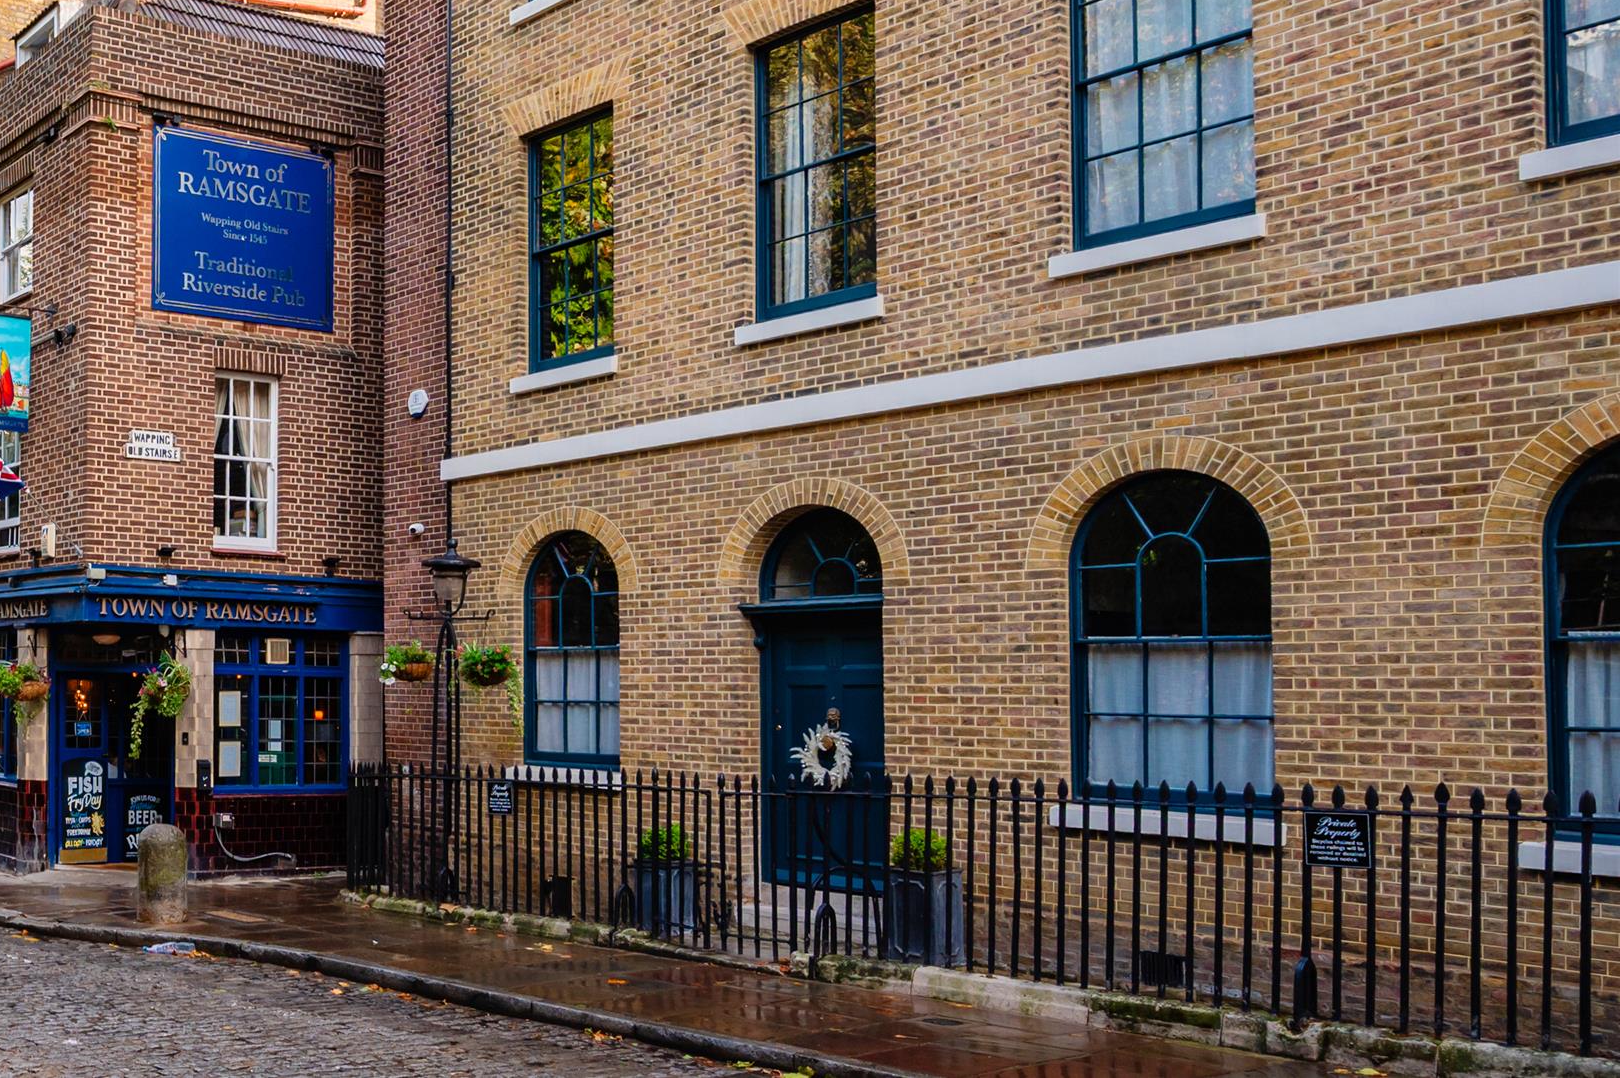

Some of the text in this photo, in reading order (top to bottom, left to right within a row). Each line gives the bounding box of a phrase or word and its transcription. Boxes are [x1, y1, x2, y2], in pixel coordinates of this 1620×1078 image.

[203, 149, 288, 184] Town of
[178, 171, 312, 214] RAMSGATE
[201, 212, 289, 235] Wapping Old Stairs
[223, 228, 268, 245] Since 1545
[194, 250, 294, 283] Traditional
[182, 272, 306, 307] Riverside Pub
[133, 432, 171, 445] WAPPING
[128, 446, 143, 456] OLD
[144, 447, 173, 459] STAIRS
[96, 597, 318, 623] TOWN OF RAMSGATE
[68, 776, 103, 795] FISH
[128, 810, 157, 825] BEER
[1317, 816, 1357, 827] Private
[1314, 826, 1361, 840] Property
